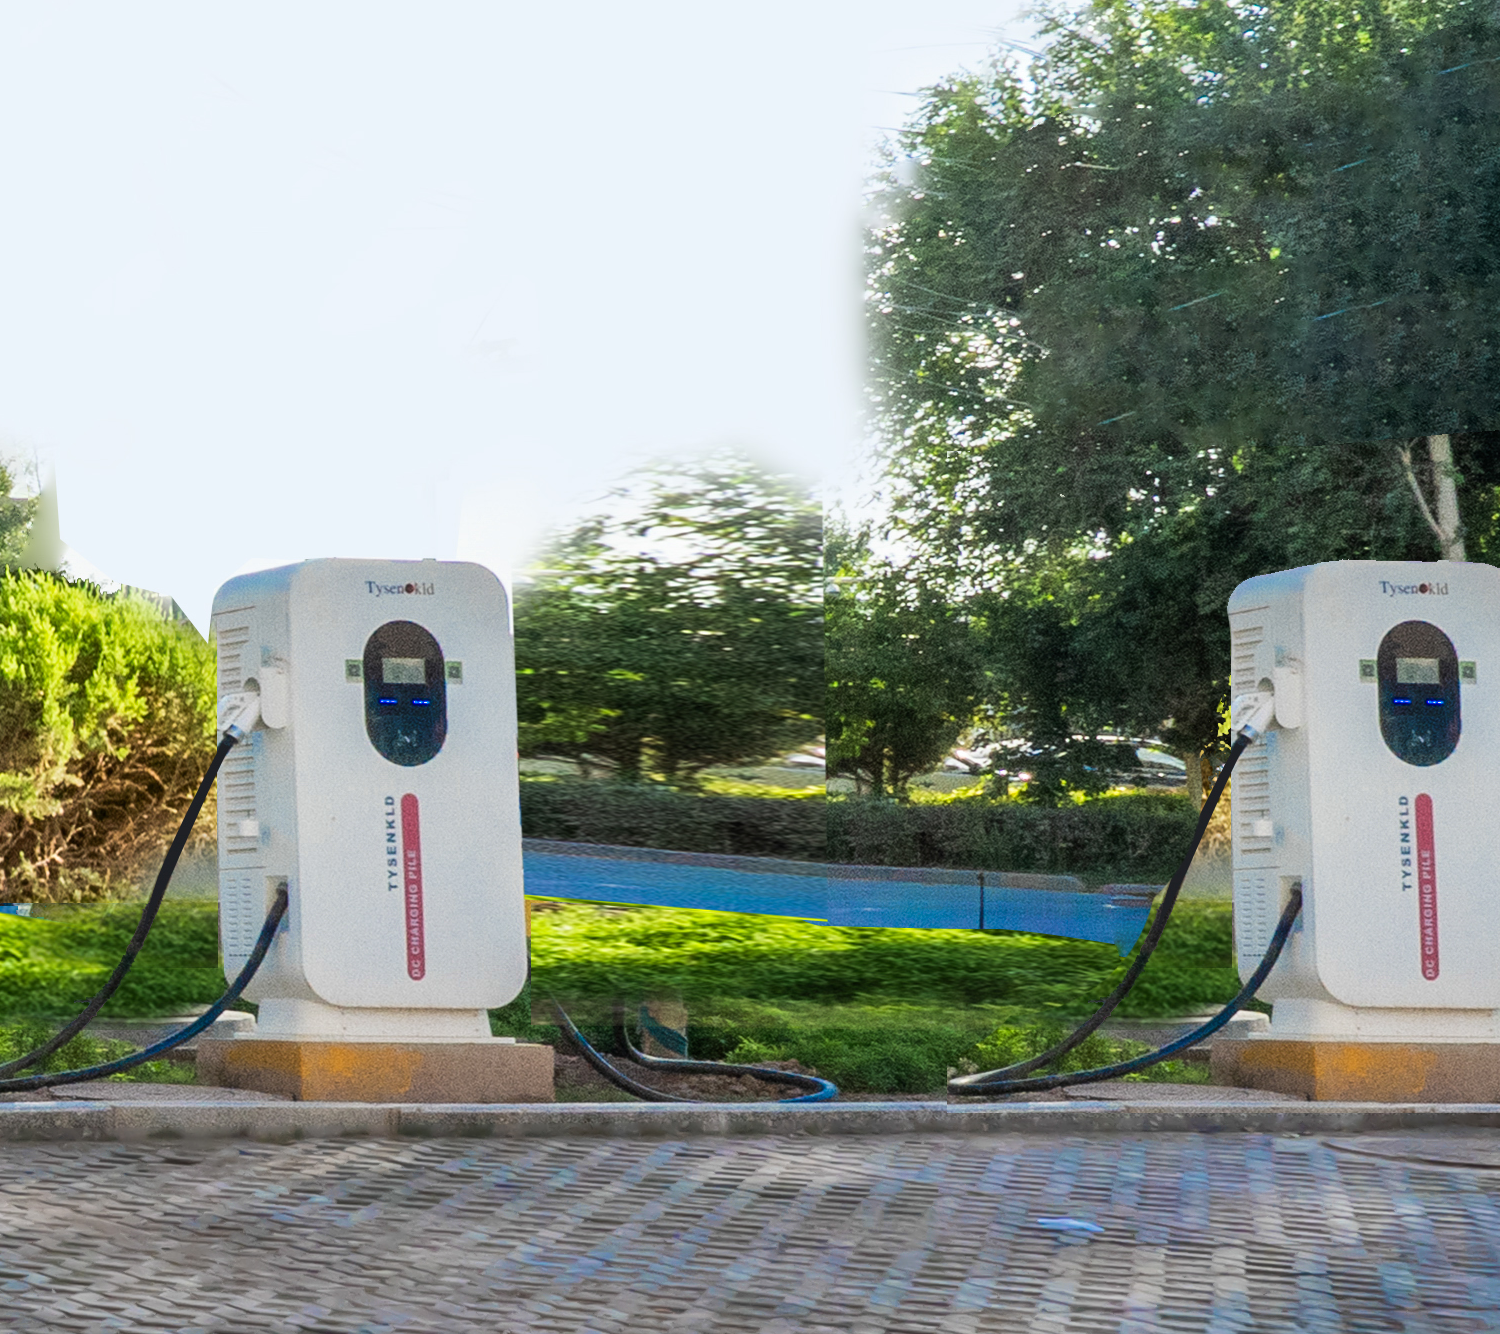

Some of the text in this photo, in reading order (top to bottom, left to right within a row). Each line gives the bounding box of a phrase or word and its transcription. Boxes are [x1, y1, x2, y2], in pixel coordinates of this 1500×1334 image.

[385, 796, 398, 892] TYSENKLD
[1399, 796, 1412, 892] TYSENKLD
[407, 849, 421, 978] DC CHARGING PILE
[1421, 849, 1435, 978] DC CHARGING PILE
